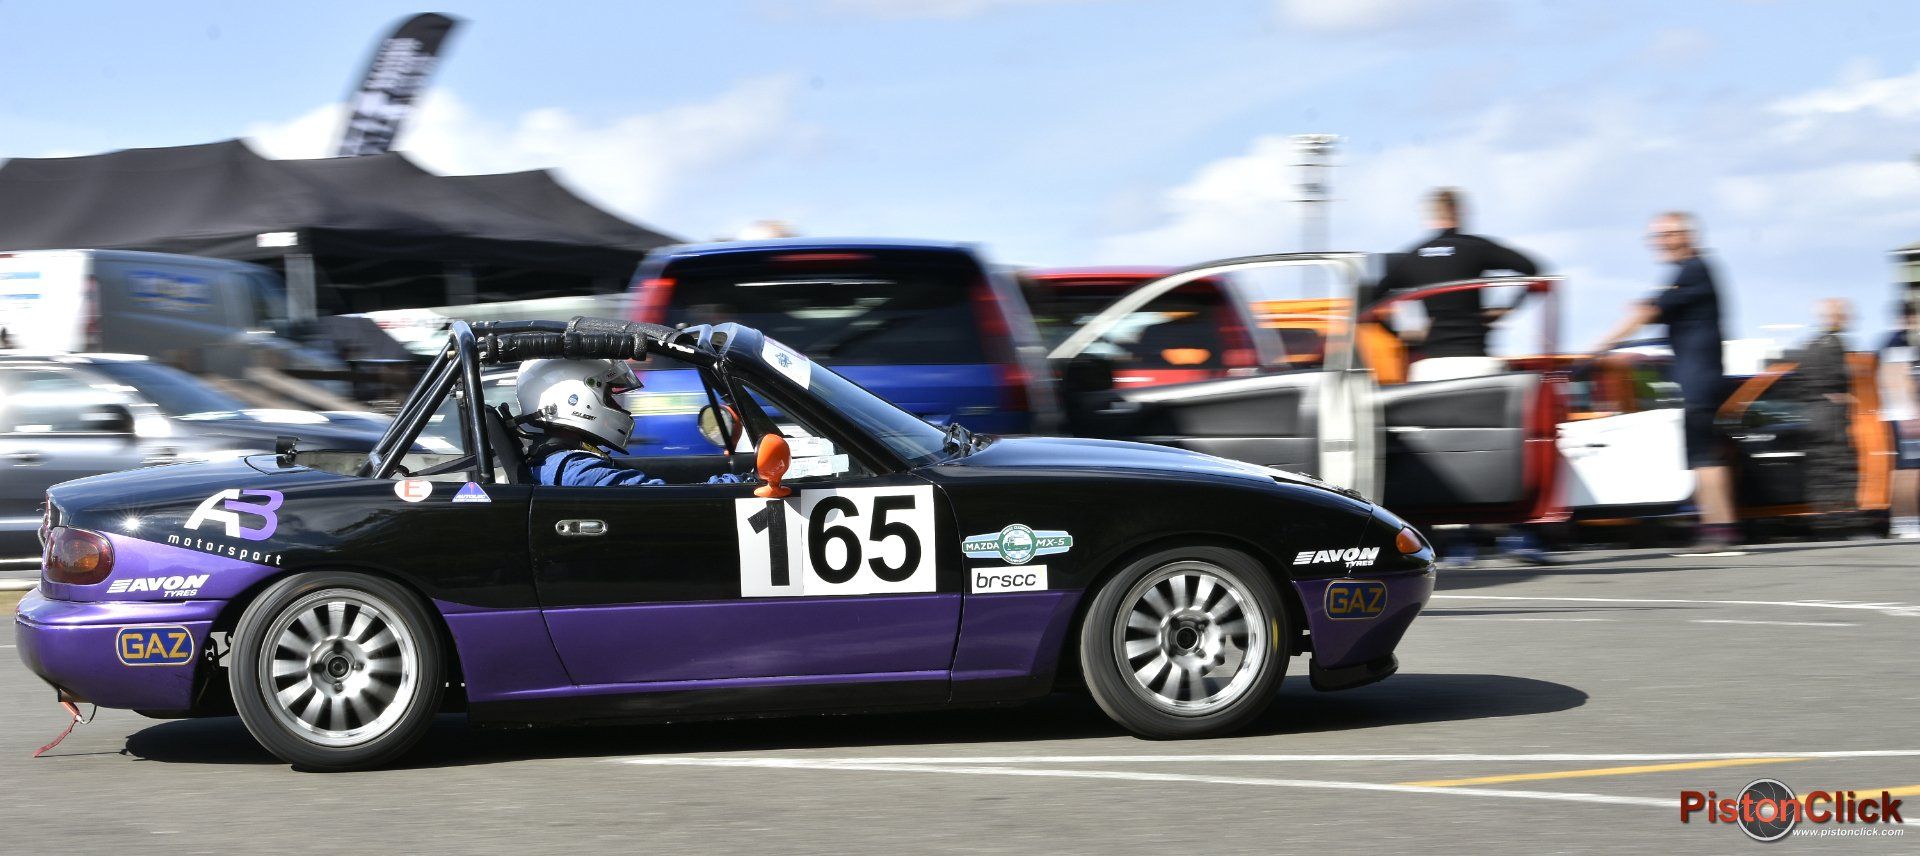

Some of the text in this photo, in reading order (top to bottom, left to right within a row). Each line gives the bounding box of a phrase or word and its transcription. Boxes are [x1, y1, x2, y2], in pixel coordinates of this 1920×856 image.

[404, 480, 423, 497] E
[747, 494, 922, 586] 165
[966, 537, 1065, 551] MAZDA MX-5
[168, 534, 282, 565] motorsport
[1312, 547, 1380, 563] AVON
[1345, 560, 1374, 568] TYRES
[129, 574, 210, 592] AVON
[976, 573, 1036, 588] brscc
[164, 589, 198, 598] TYRES
[1330, 587, 1384, 614] GAZ
[121, 633, 189, 659] GAZ
